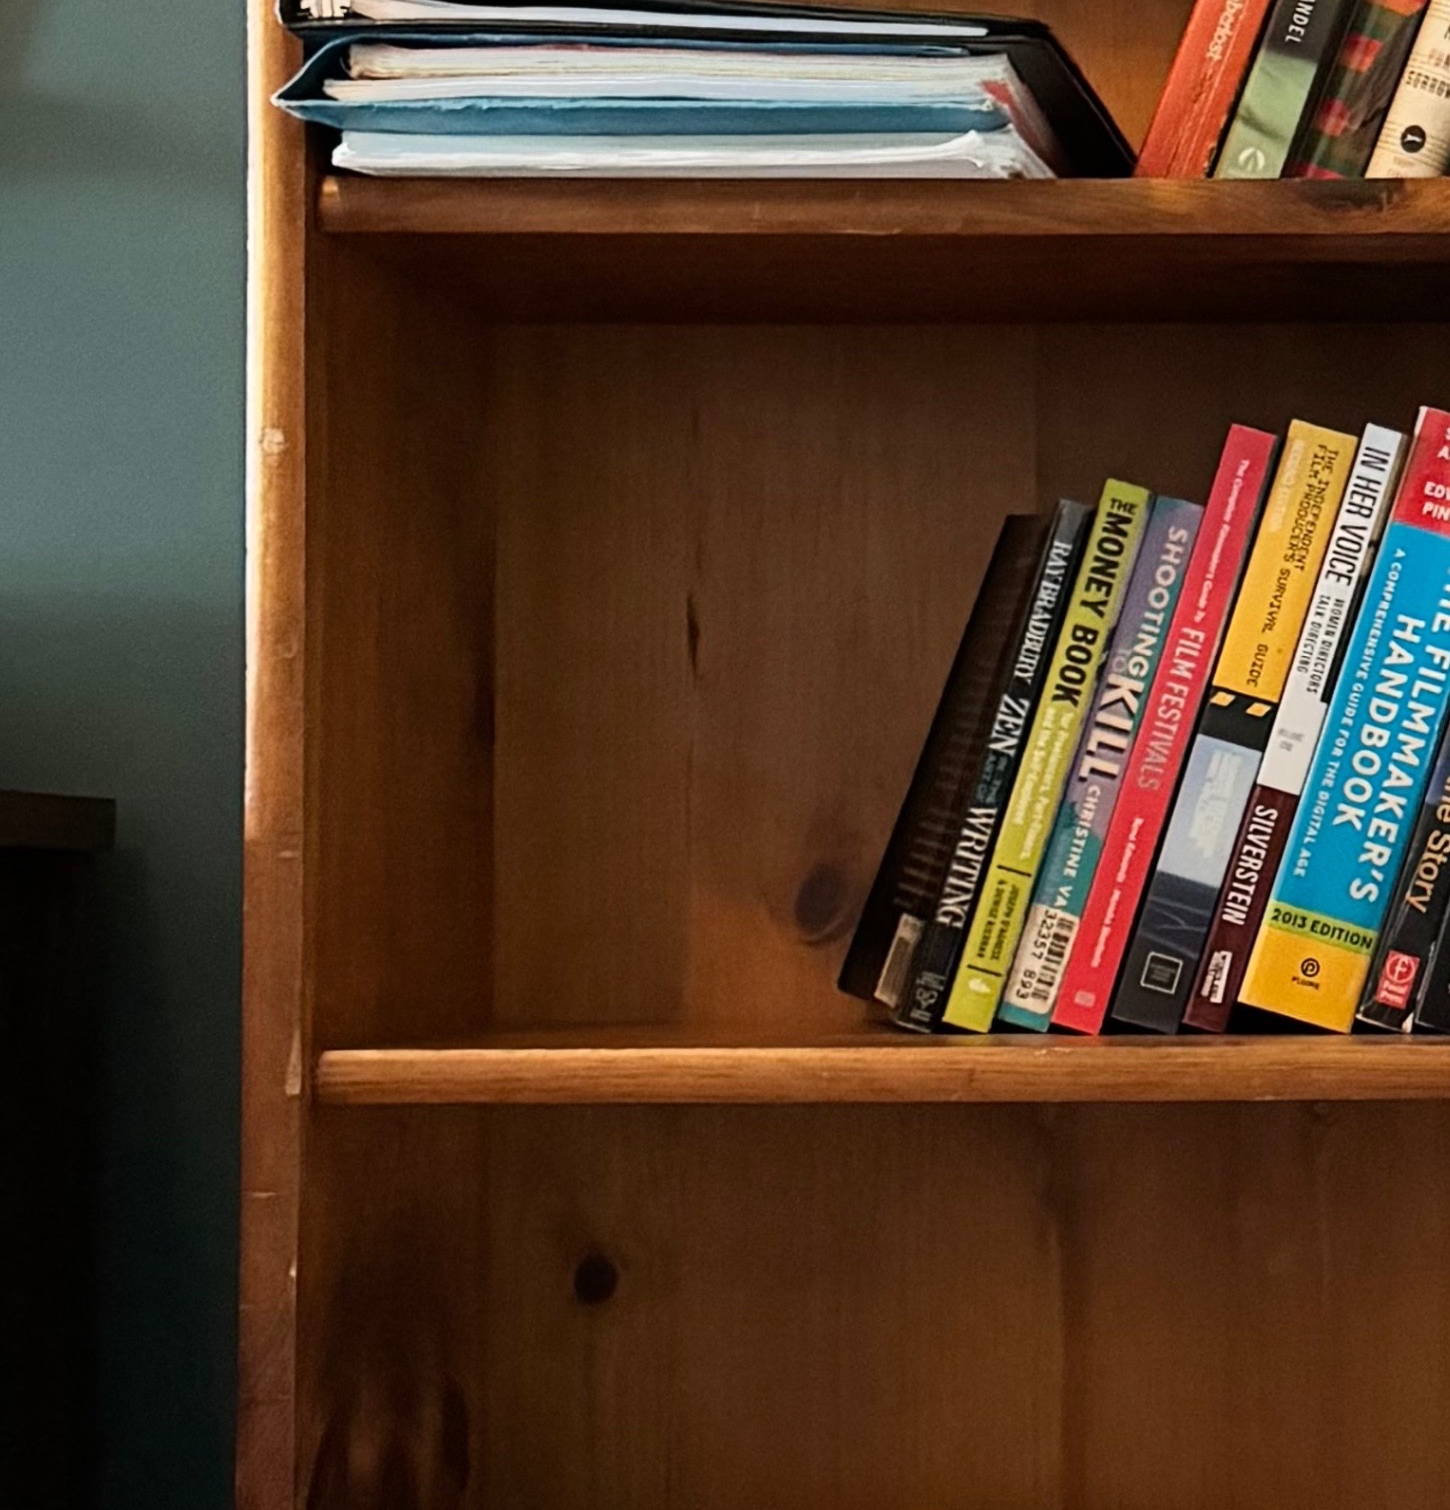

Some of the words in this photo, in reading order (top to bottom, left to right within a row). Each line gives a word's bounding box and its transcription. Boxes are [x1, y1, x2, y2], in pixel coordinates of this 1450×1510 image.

[1306, 443, 1328, 480] FILM
[1358, 445, 1390, 473] IN
[1344, 474, 1381, 521] HER
[1042, 539, 1072, 580] RAY
[1076, 508, 1133, 618] MONEY
[1323, 518, 1368, 587] VOICE
[1393, 547, 1406, 558] A
[1125, 524, 1189, 679] SHOOTING
[1355, 560, 1401, 679] COMPREHENSIVE
[1010, 580, 1059, 686] BRADBURY
[1169, 625, 1206, 679] FILM
[1051, 622, 1100, 707] BOOK
[1244, 642, 1269, 688] GUIDE
[986, 692, 1030, 756] ZEN
[1077, 671, 1146, 788] KILL
[1331, 613, 1425, 831] HANDBOOK
[1340, 682, 1362, 725] GUIDE
[1135, 680, 1191, 794] FESTIVALS
[1330, 729, 1349, 757] FOR
[1321, 759, 1340, 787] THE
[1062, 783, 1102, 878] CHRISTINE
[1303, 790, 1331, 845] DIGITAL
[935, 801, 996, 929] WRITING
[1220, 804, 1279, 926] SILVERSTEIN
[1293, 847, 1311, 877] AGE
[1028, 908, 1059, 960] 32357
[1270, 906, 1304, 931] 2013
[1307, 916, 1375, 952] EDITION
[1014, 968, 1039, 1001] 893
